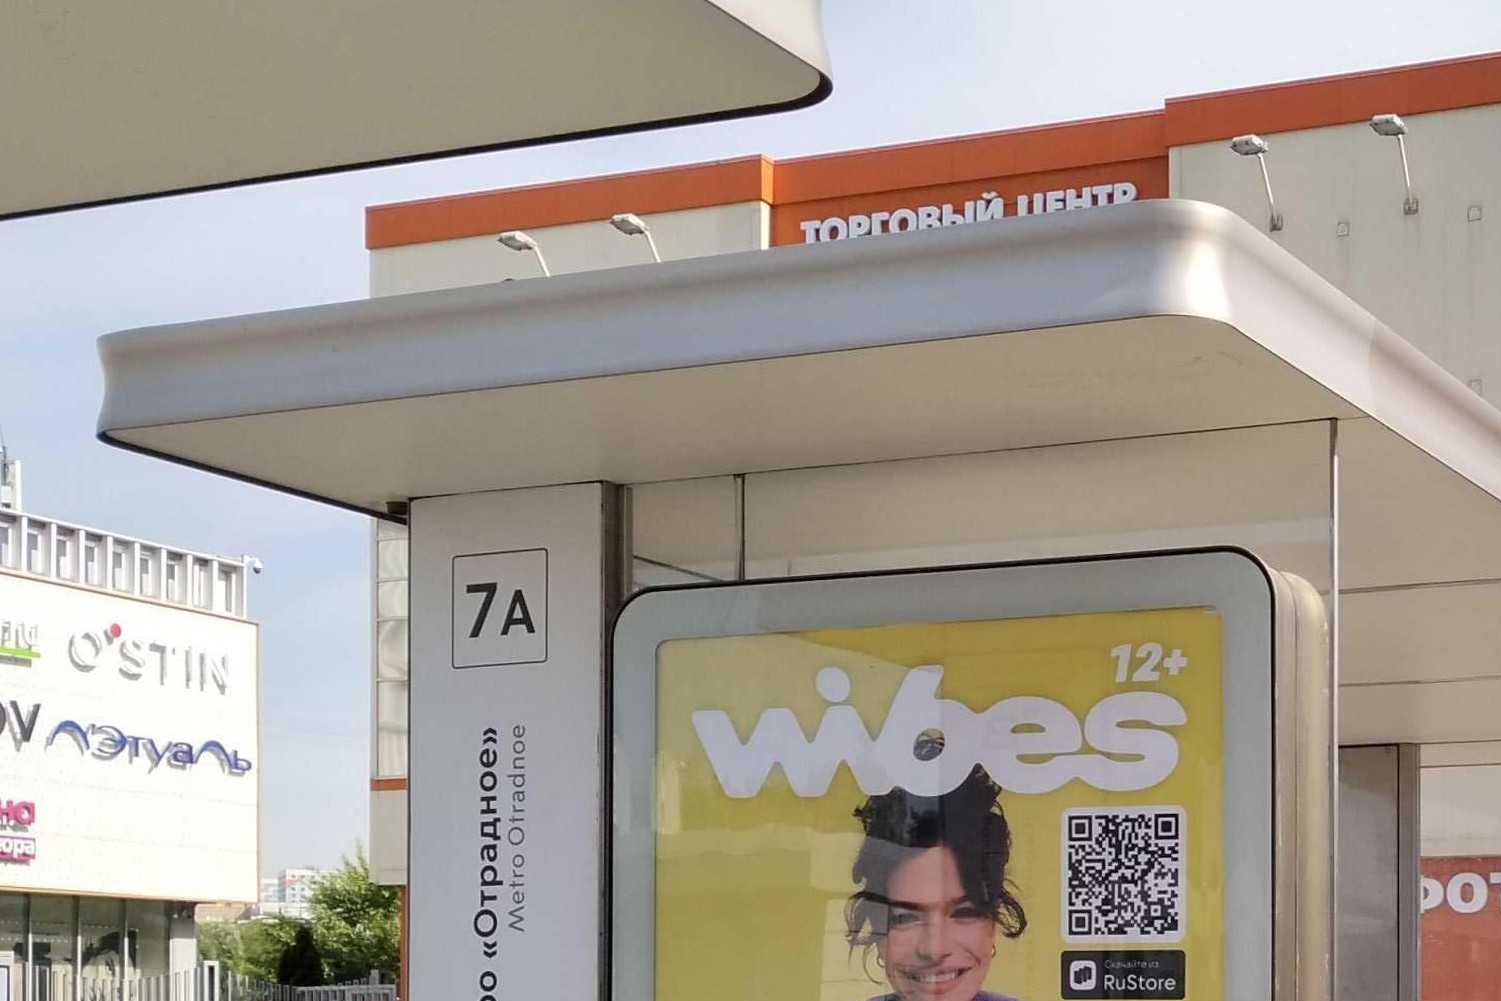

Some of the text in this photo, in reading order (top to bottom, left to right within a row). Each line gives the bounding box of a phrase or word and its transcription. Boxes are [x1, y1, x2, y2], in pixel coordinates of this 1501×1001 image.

[800, 182, 1138, 244] ТОРГОВЫЙ ЦЕНТР
[466, 582, 536, 638] 7А
[1110, 642, 1189, 683] 12+
[691, 664, 1188, 798] wibes
[473, 727, 504, 959] «Отрадное»
[506, 724, 526, 932] Metro Otradnoe
[1103, 973, 1177, 991] RuStore
